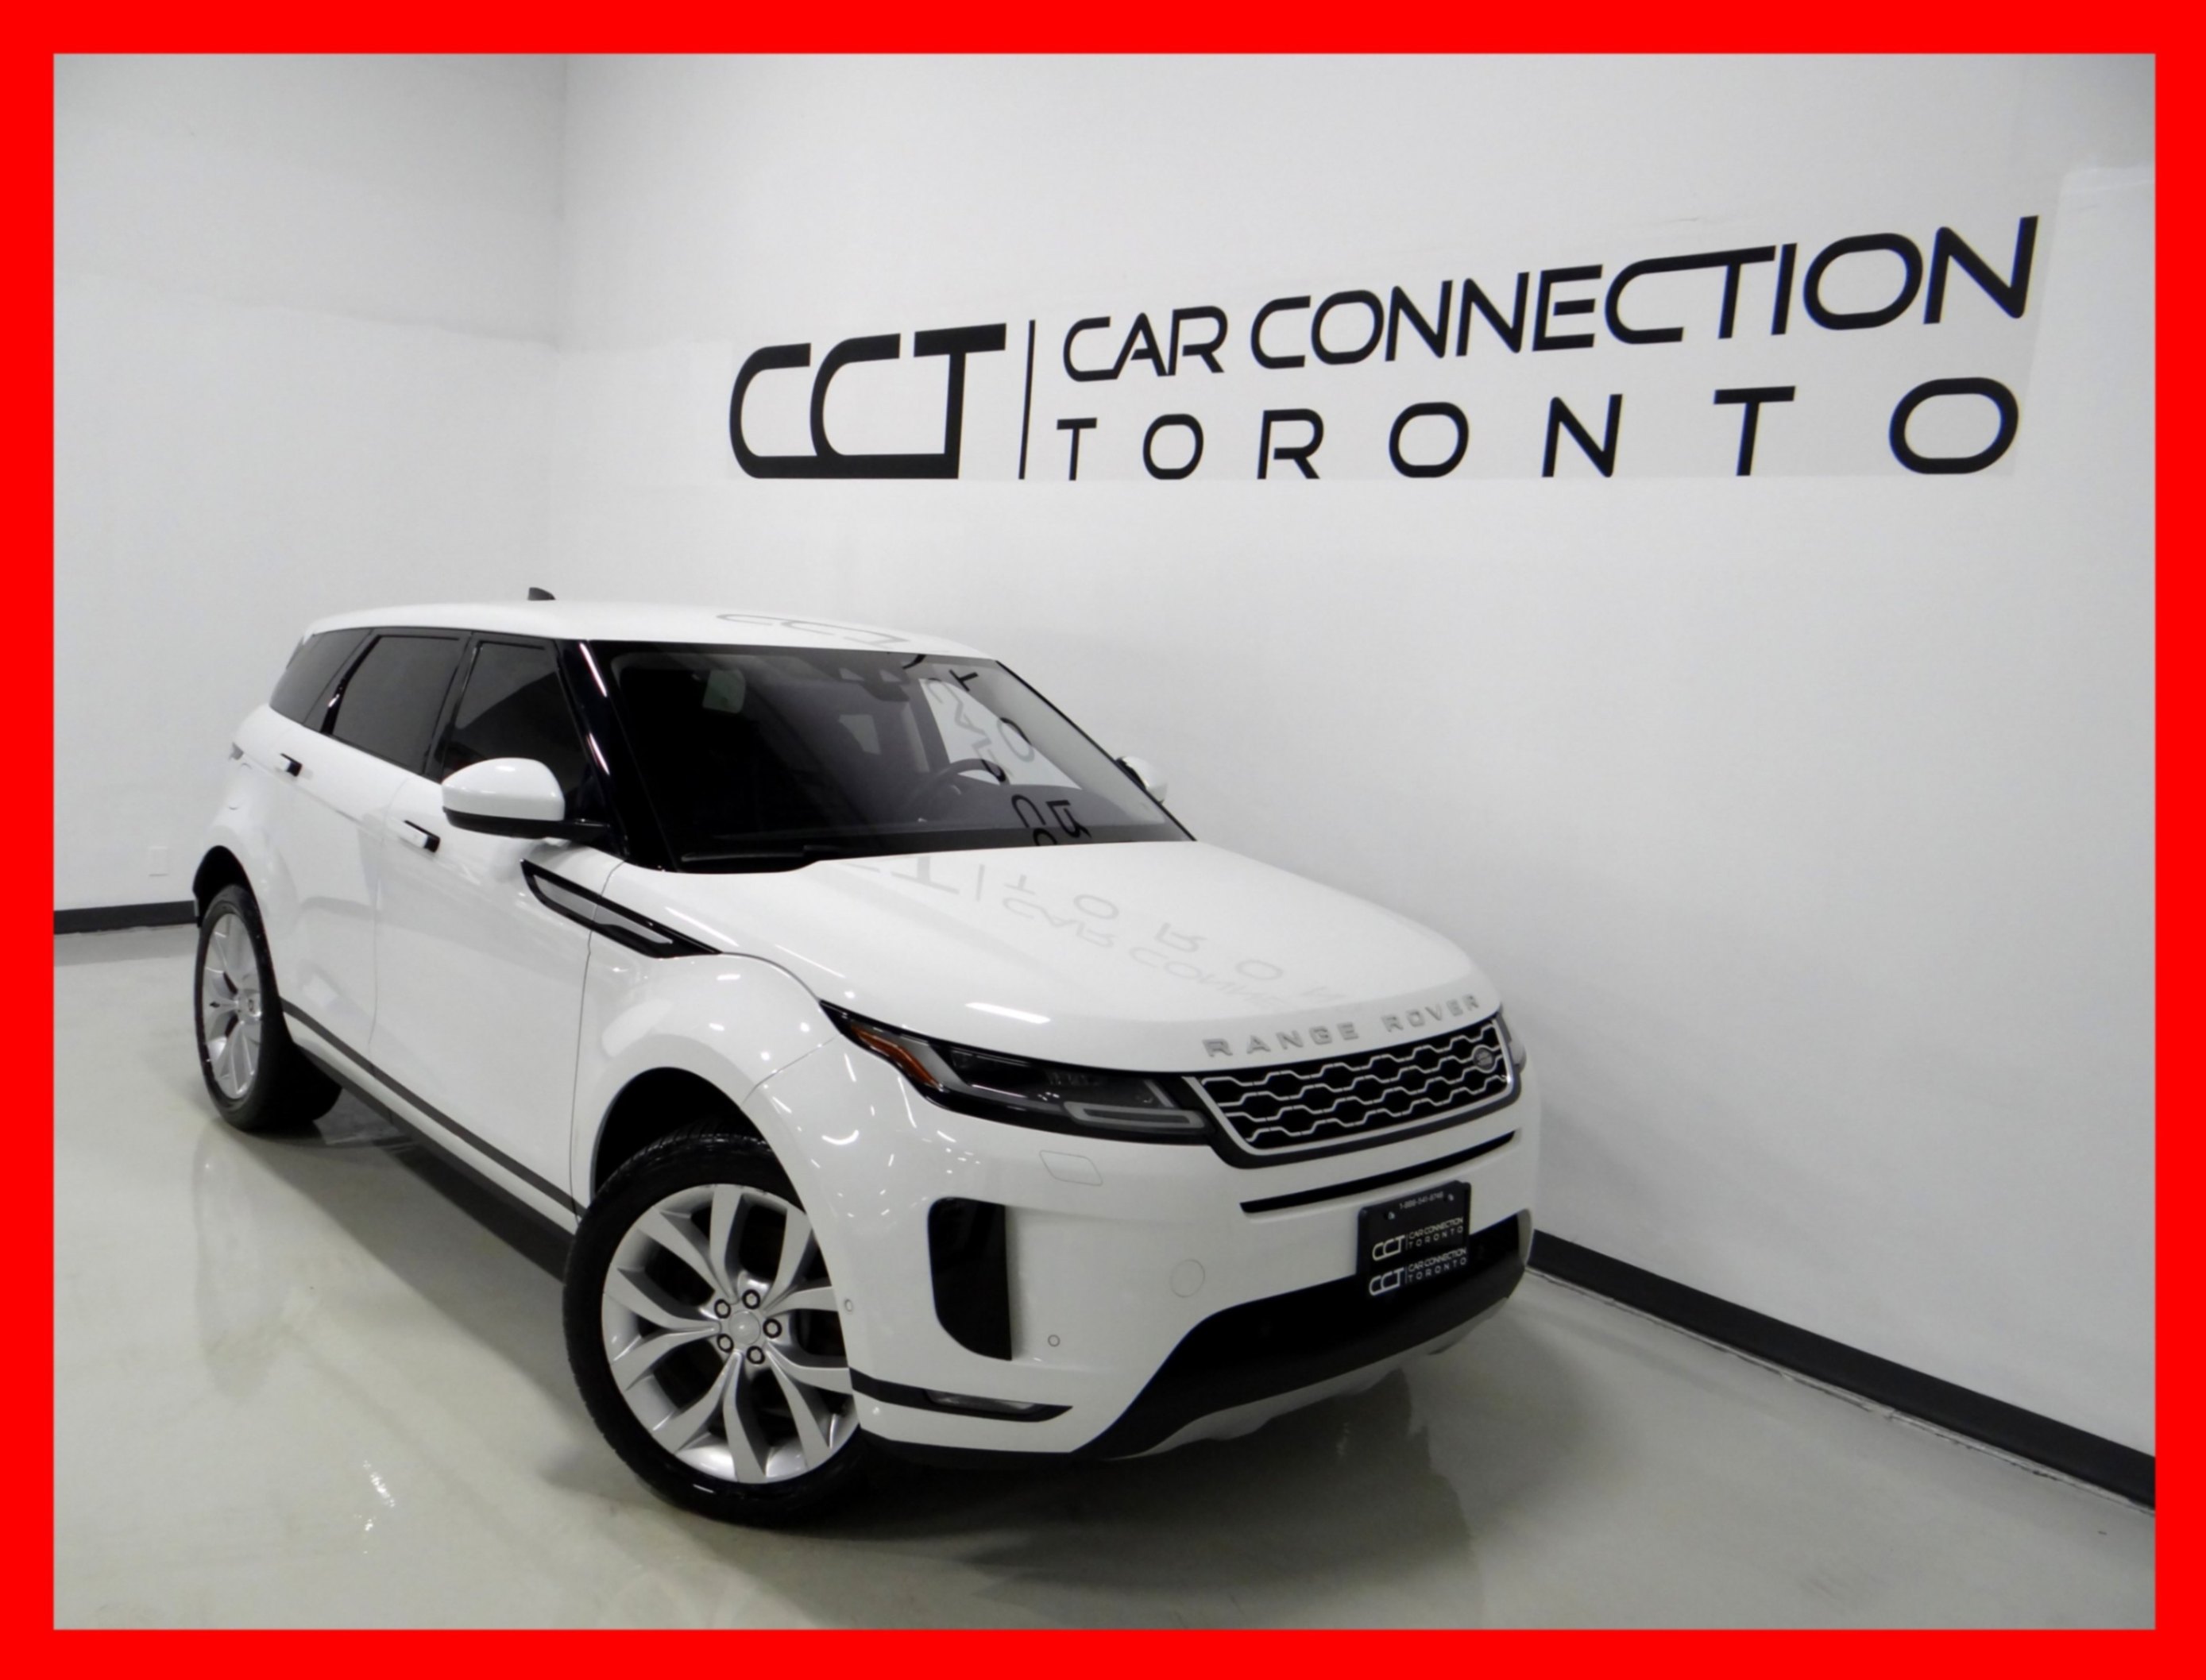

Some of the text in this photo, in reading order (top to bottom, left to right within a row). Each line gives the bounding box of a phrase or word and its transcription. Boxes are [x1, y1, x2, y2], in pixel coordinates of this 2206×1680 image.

[1063, 215, 2038, 382] CAR CONNECTION
[730, 322, 1006, 480] CCT
[1057, 377, 2019, 481] TORONTO
[1201, 994, 1480, 1058] RANGE ROVER
[1408, 1217, 1464, 1240] CAR CONNECTION
[1408, 1225, 1464, 1249] TORONTO
[1372, 1234, 1406, 1261] CCT
[1408, 1247, 1467, 1273] CAR CONNECTION
[1369, 1266, 1404, 1296] CCT
[1408, 1257, 1467, 1283] TORONTO
